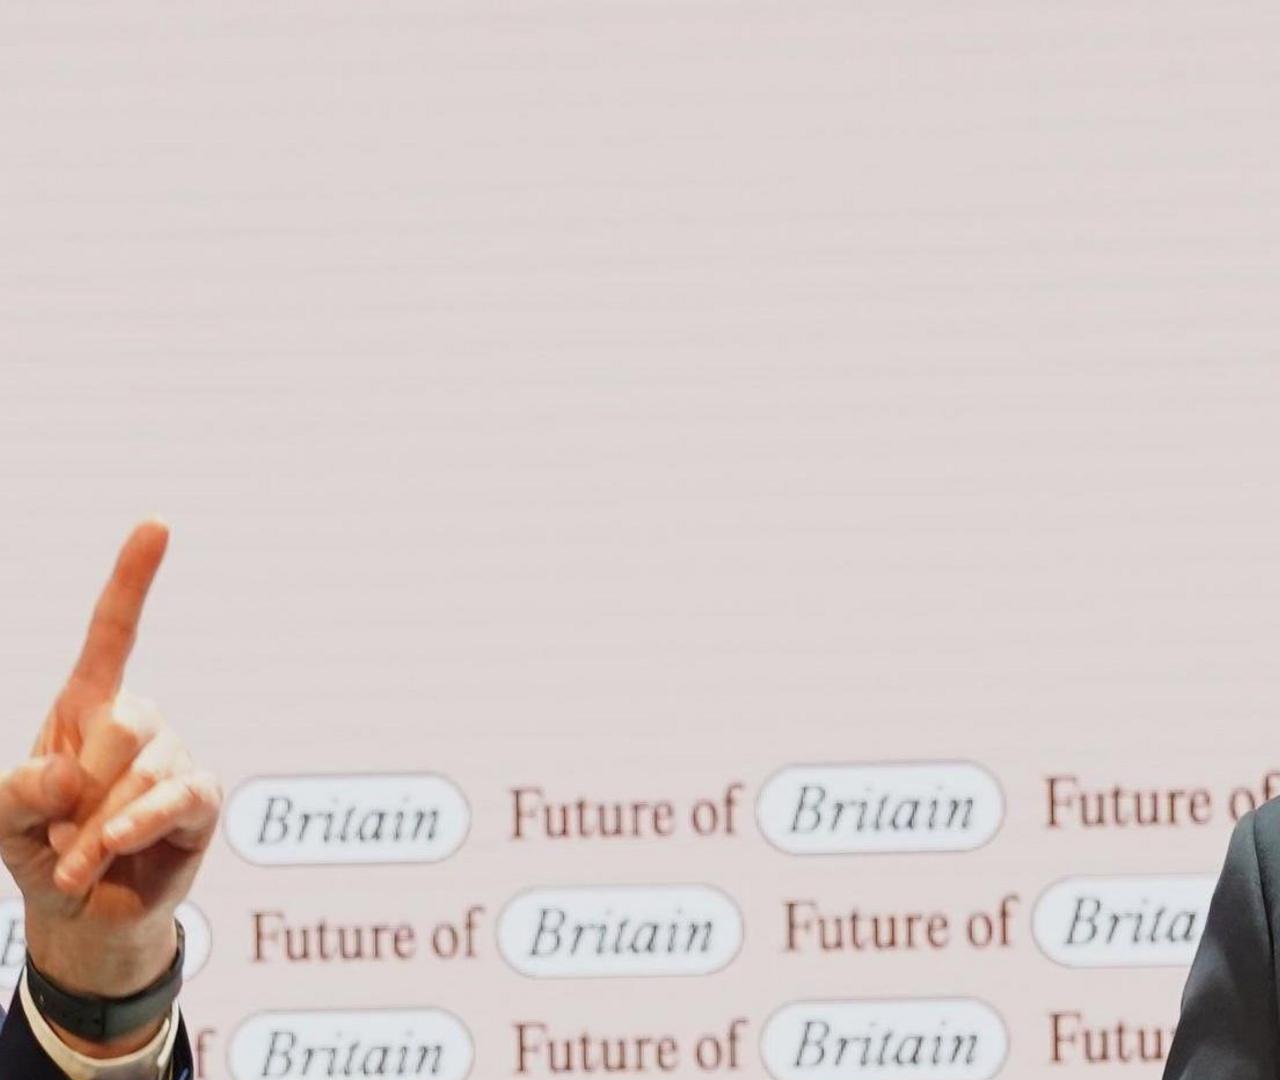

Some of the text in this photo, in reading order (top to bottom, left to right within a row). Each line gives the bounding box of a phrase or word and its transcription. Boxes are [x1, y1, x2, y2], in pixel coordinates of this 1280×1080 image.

[257, 796, 439, 845] Britain
[510, 782, 974, 841] Future of Britain
[1044, 775, 1213, 830] Future
[251, 905, 713, 964] Future of Britain
[783, 893, 1197, 953] Future of Brita
[261, 1031, 443, 1079] Britain
[512, 1017, 978, 1076] Future of Britain
[1048, 1010, 1176, 1063] Futu
